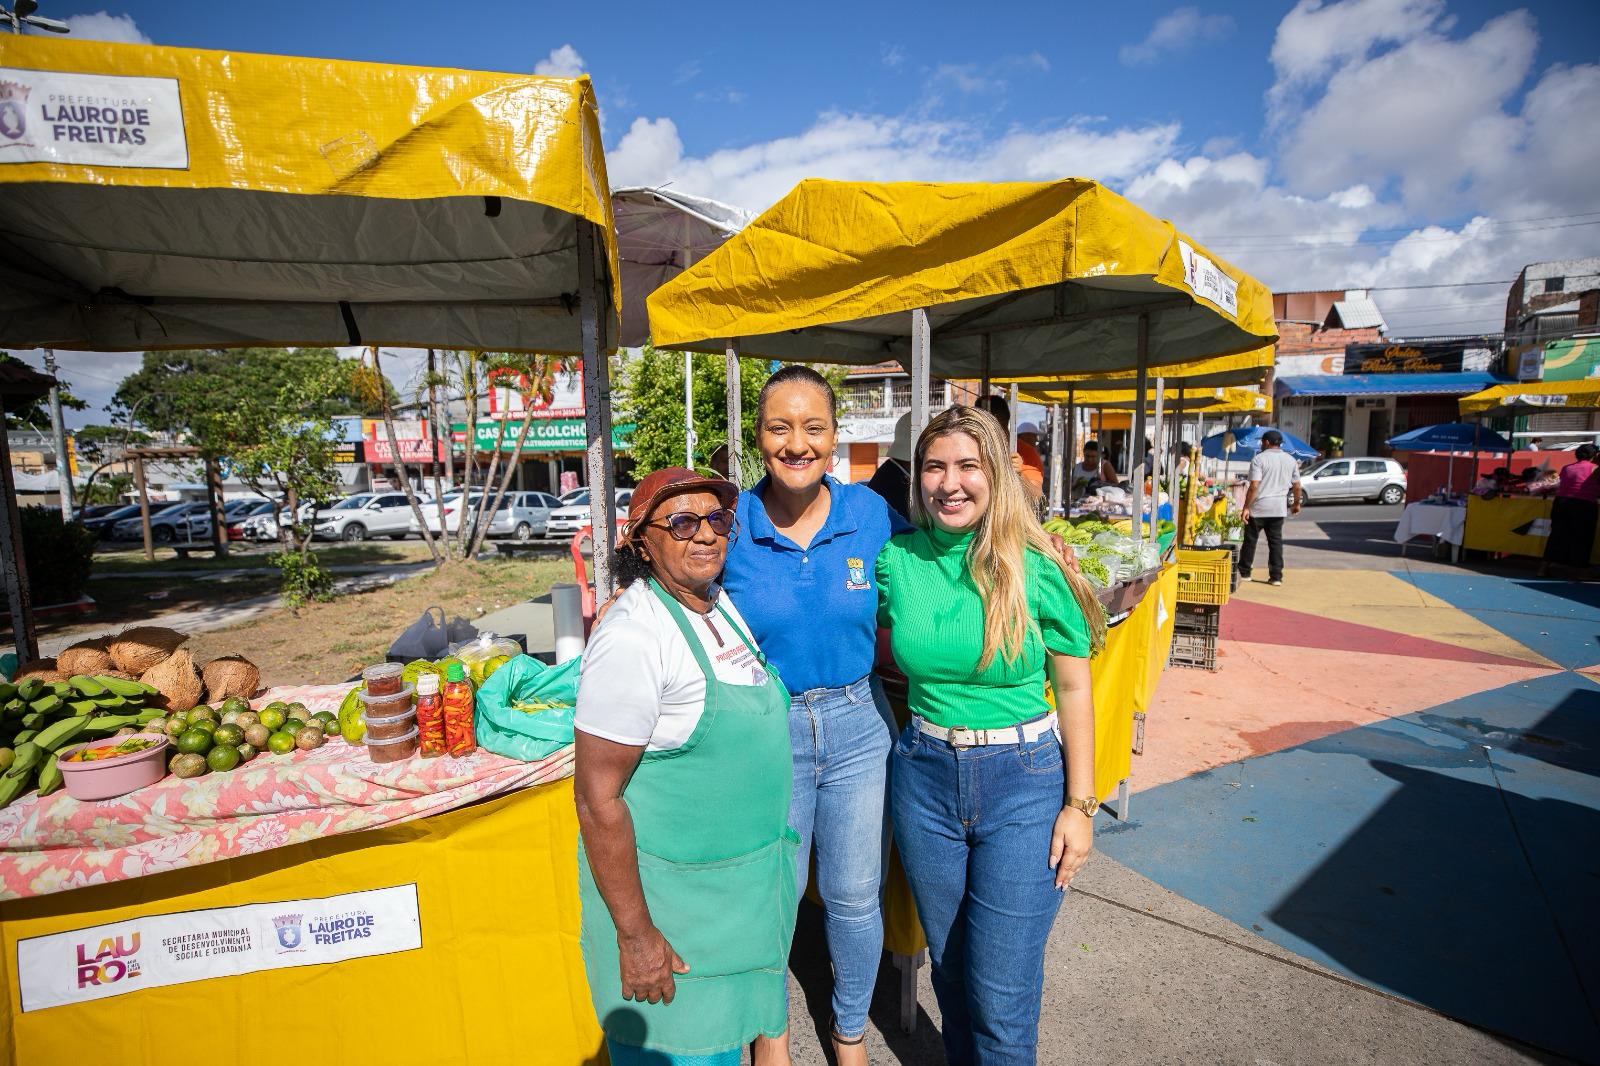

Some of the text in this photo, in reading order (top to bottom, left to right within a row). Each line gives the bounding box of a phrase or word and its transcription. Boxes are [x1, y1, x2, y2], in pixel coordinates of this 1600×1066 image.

[49, 94, 138, 107] PREFEITURA
[41, 104, 151, 126] LAURO DE
[52, 124, 147, 146] FREITAS
[477, 425, 508, 440] CASA
[510, 425, 535, 439] DOS
[308, 915, 375, 933] LAURO DE
[314, 910, 367, 921] PREFEITURA
[162, 927, 249, 946] SECRETARIA MUNICIPAL
[168, 935, 251, 954] DE DESENVOLVIMENTO
[315, 927, 372, 944] FREITAS
[176, 943, 252, 961] SOCIAL E CIDADANIA
